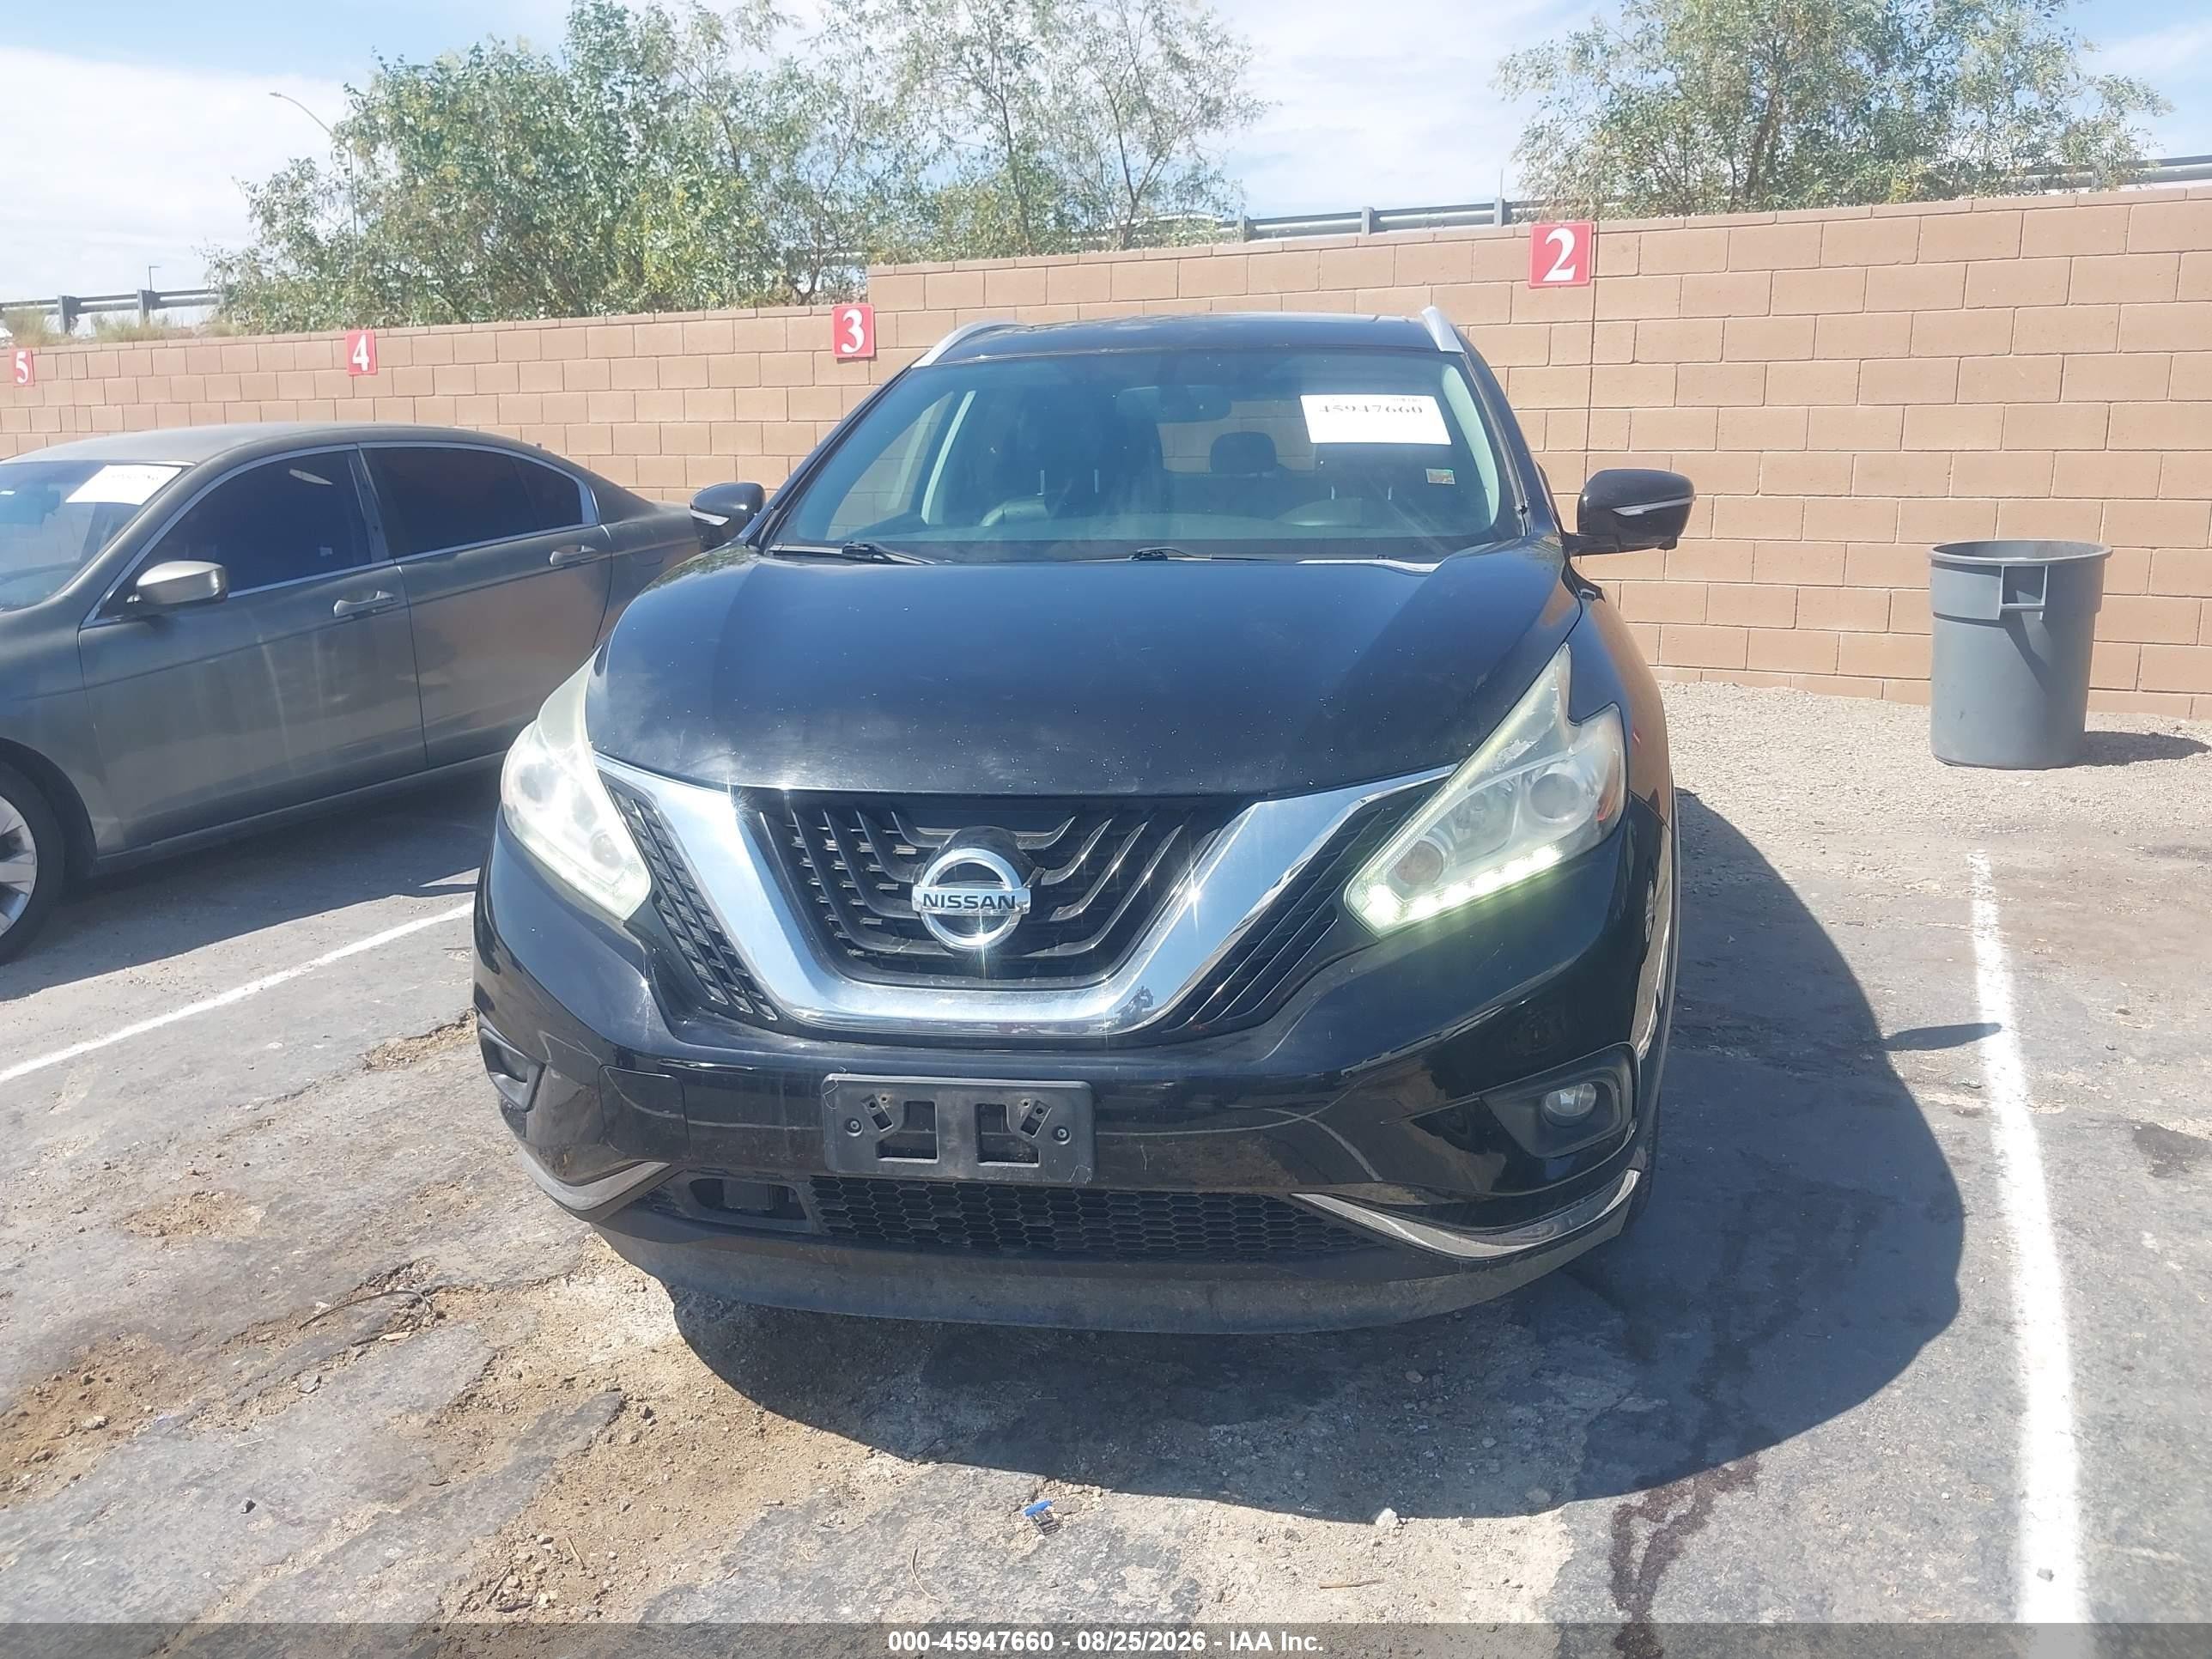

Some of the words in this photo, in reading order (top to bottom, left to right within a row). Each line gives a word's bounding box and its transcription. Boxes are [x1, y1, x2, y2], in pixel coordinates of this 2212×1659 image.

[1542, 227, 1577, 283] 2
[841, 308, 866, 354] 3
[15, 350, 29, 385] 5
[352, 333, 370, 372] 4
[922, 893, 1017, 909] NISSAN
